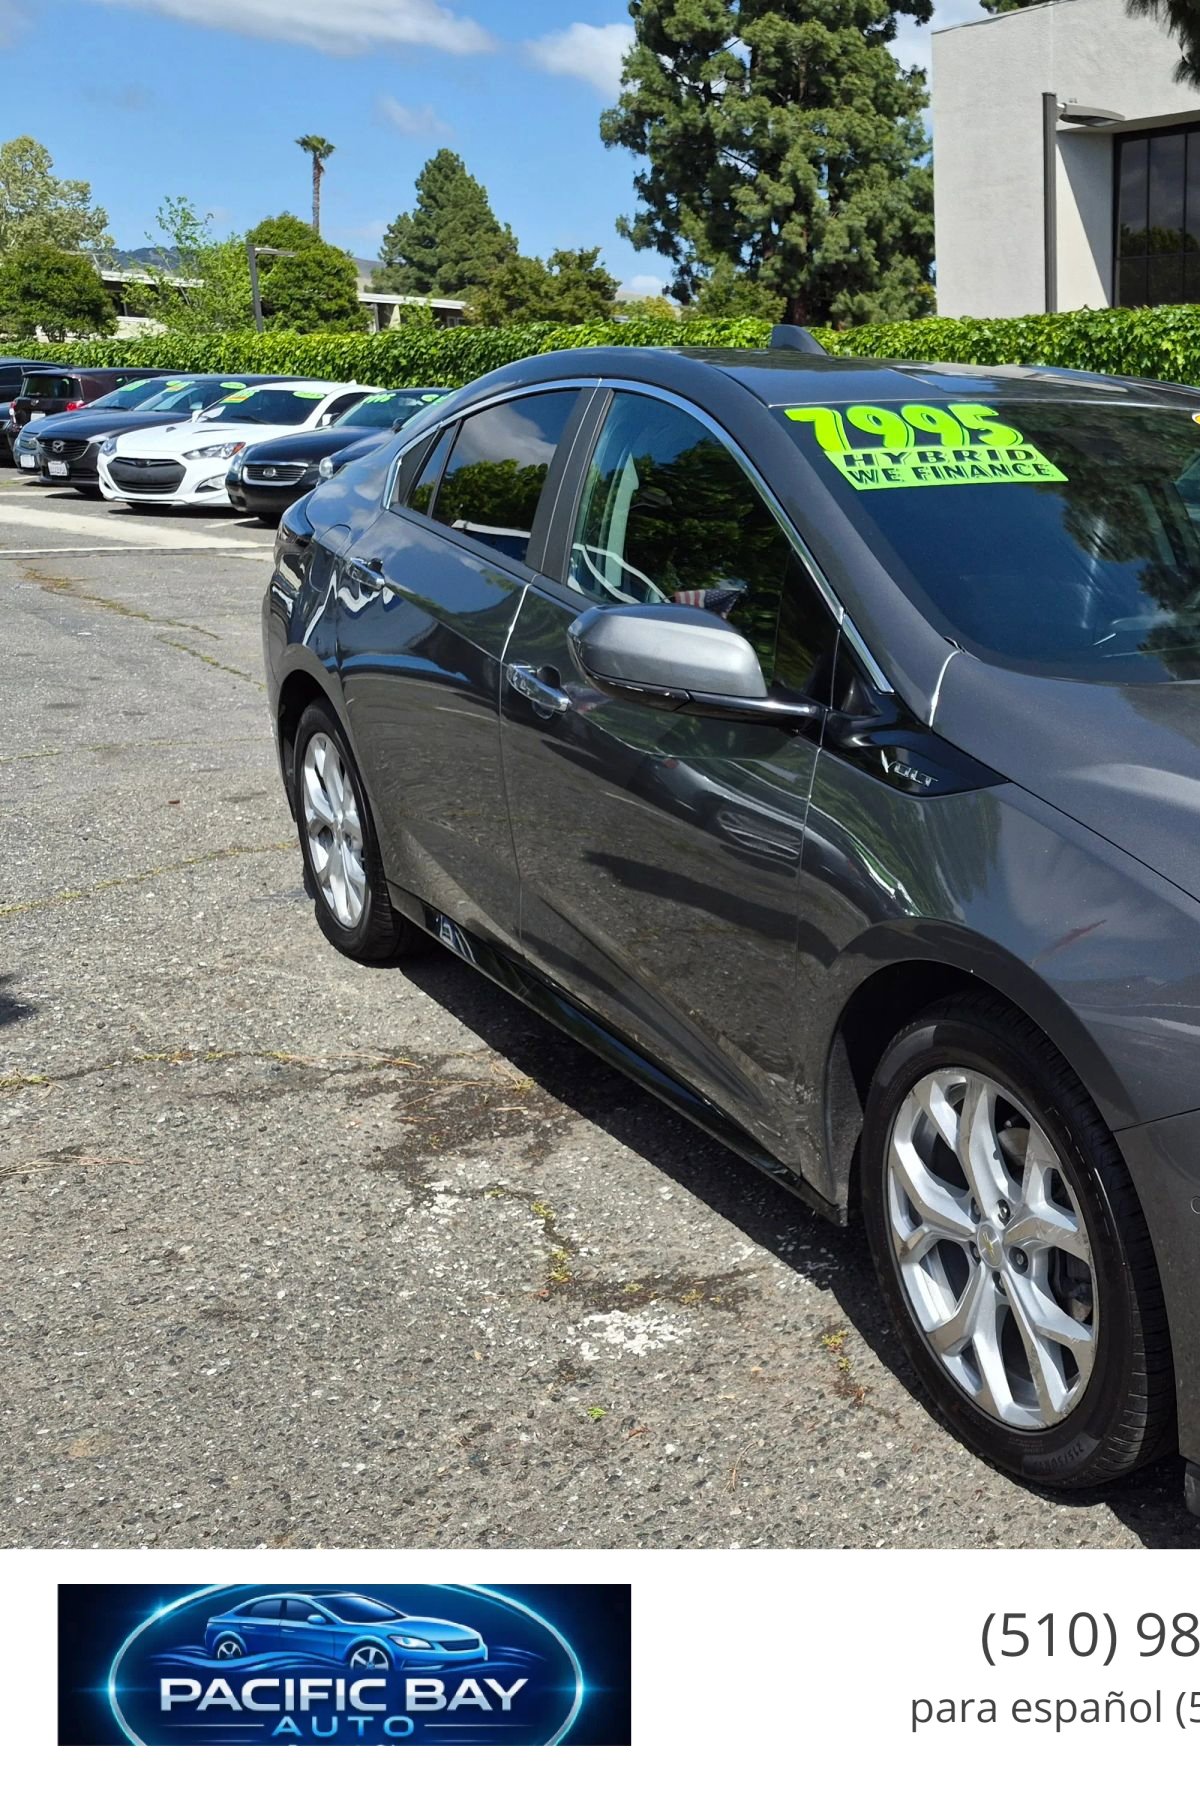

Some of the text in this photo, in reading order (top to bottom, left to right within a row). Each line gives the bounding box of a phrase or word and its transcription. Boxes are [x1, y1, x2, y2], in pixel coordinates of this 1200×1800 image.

[784, 404, 1025, 453] 7995
[843, 448, 1038, 468] HYBRID
[846, 462, 1053, 485] WE FINANCE
[881, 749, 939, 788] VOLT
